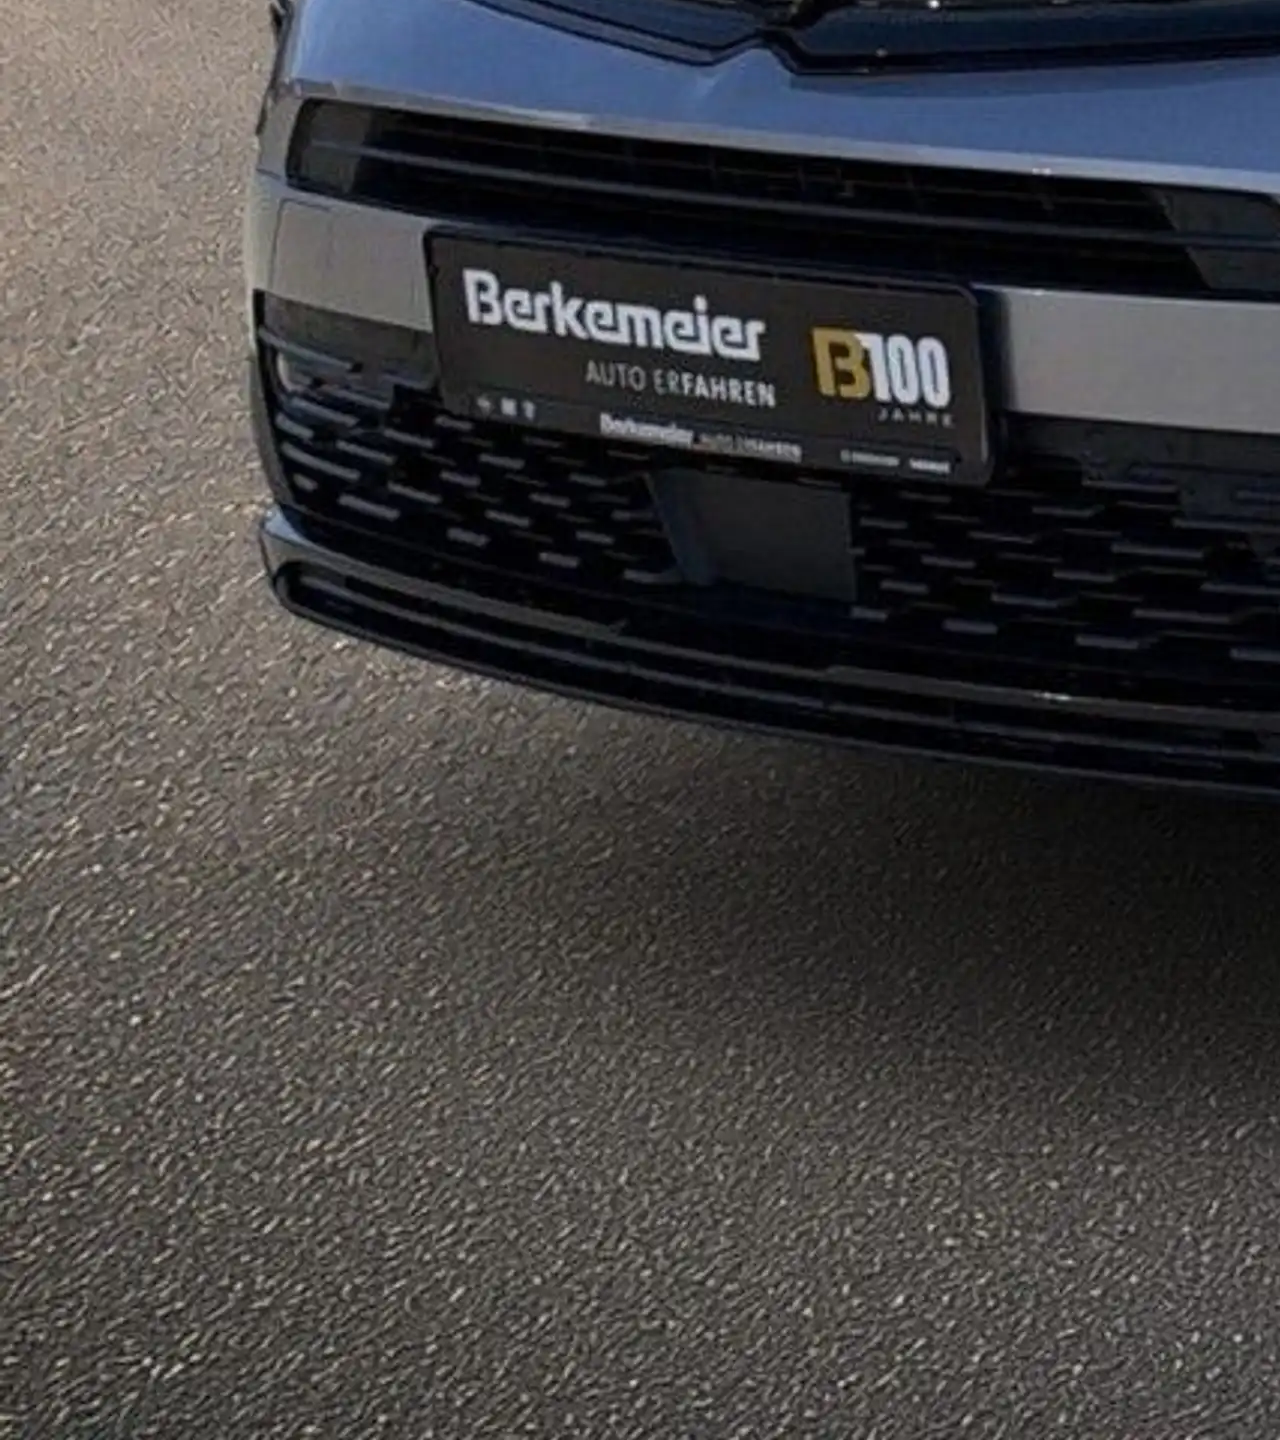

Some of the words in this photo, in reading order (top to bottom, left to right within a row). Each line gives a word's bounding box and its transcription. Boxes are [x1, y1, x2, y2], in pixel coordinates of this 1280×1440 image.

[462, 267, 766, 361] Berkemeier
[585, 360, 646, 392] AUTO
[653, 369, 776, 408] ERFAHREN
